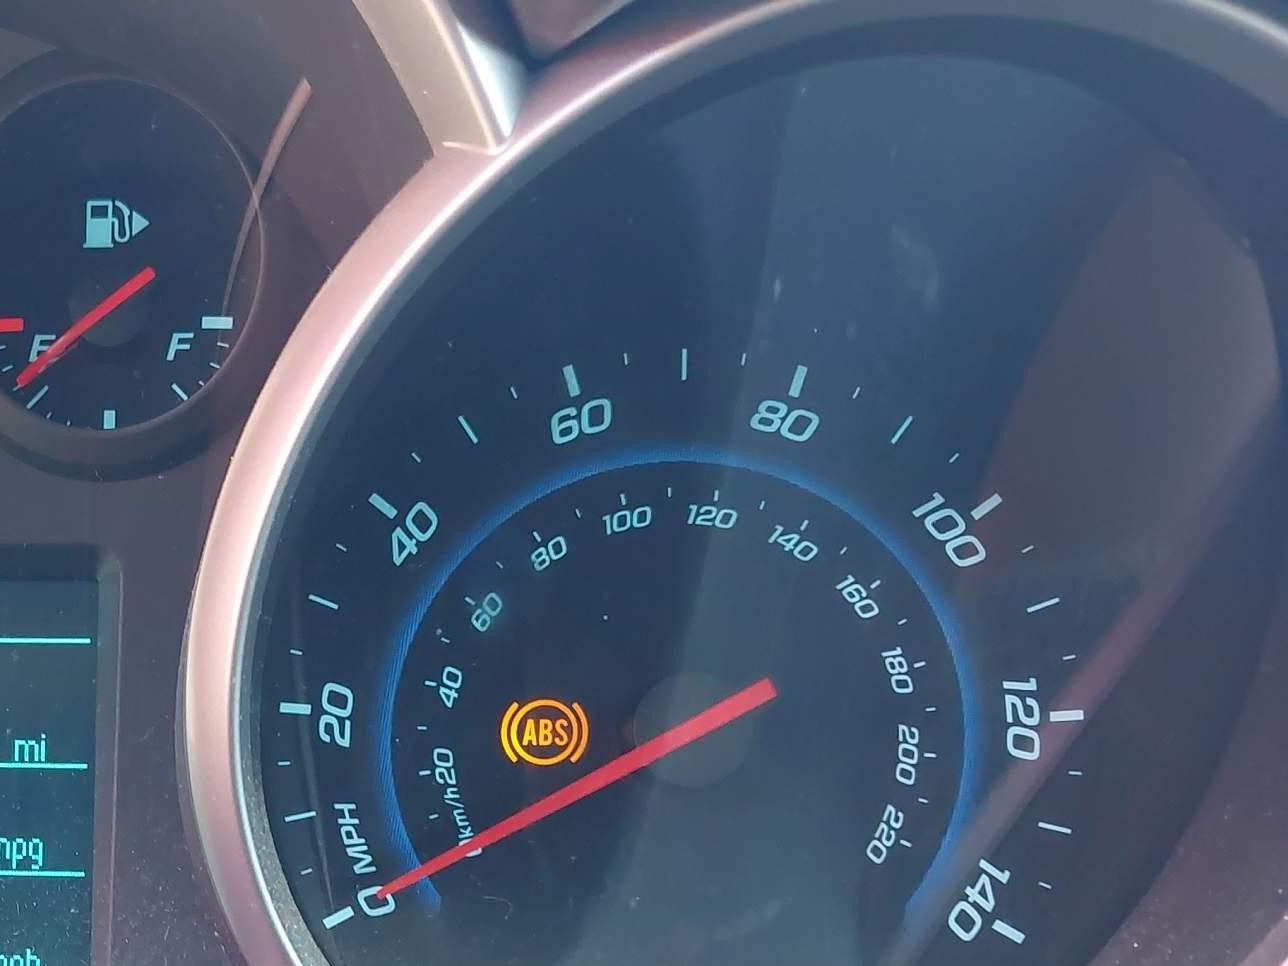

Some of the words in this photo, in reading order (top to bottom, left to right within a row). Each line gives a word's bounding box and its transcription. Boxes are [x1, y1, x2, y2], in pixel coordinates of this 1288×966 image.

[167, 333, 194, 360] F
[550, 398, 612, 444] 60
[750, 399, 819, 442] 80
[391, 502, 437, 566] 40
[603, 506, 652, 534] 100
[687, 504, 737, 529] 120
[912, 493, 986, 567] 100
[531, 536, 567, 571] 80
[768, 525, 818, 562] 140
[472, 592, 502, 631] 60
[836, 575, 879, 619] 160
[439, 666, 463, 708] 40
[881, 646, 913, 694] 180
[319, 682, 354, 748] 20
[523, 722, 568, 746] ABS
[1002, 677, 1040, 761] 120
[14, 734, 47, 762] mi
[433, 748, 456, 785] 20
[895, 724, 920, 785] 200
[444, 787, 474, 839] km/h
[866, 805, 904, 864] 220
[334, 804, 377, 874] MPH
[357, 886, 396, 917] 0
[948, 859, 1011, 942] 140
